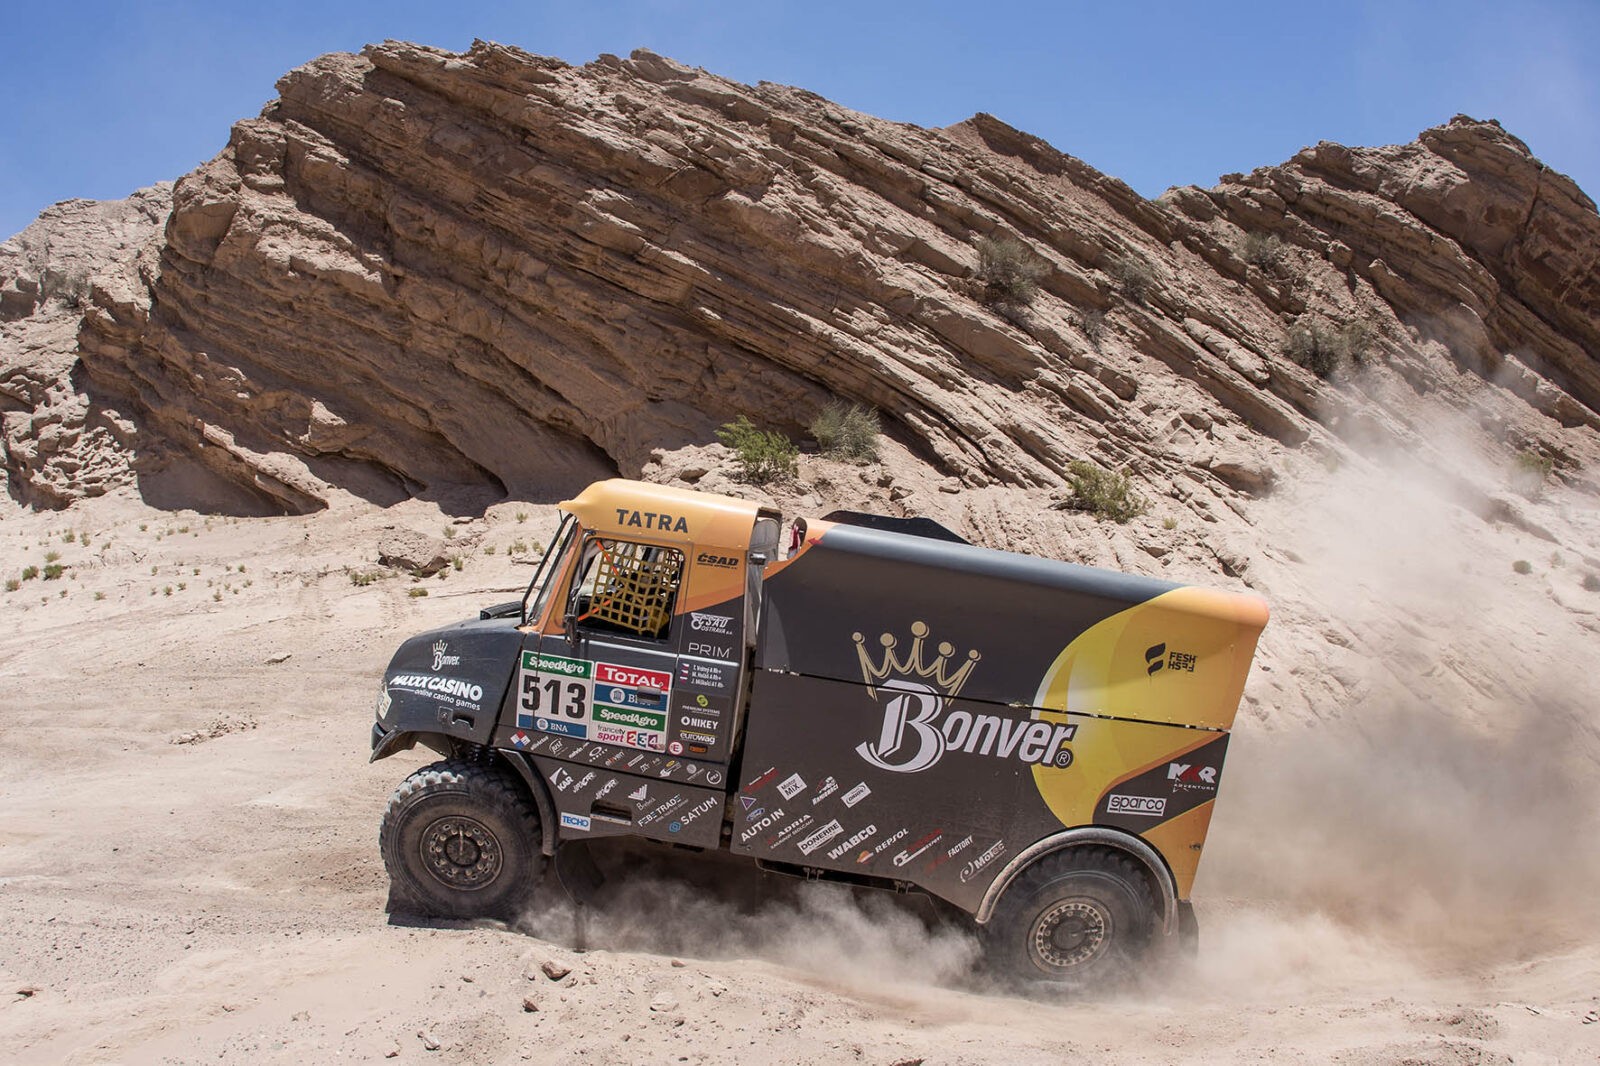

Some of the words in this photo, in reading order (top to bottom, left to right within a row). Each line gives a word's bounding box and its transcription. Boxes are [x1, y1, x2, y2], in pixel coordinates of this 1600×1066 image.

[616, 508, 688, 534] TATRA
[688, 642, 730, 659] PRIM
[1169, 651, 1197, 664] FESH
[529, 656, 585, 674] SpeedAgro
[427, 677, 483, 701] CASINO
[604, 667, 660, 688] TOTAL
[414, 688, 433, 698] online
[432, 692, 455, 704] casino
[455, 698, 481, 711] games
[522, 674, 587, 719] 513
[550, 722, 568, 733] BNA
[600, 708, 658, 727] SpeedAgro
[855, 677, 1076, 774] Bonver
[597, 732, 624, 743] sport
[556, 776, 574, 792] KAR
[680, 796, 718, 825] SATUM
[1110, 795, 1165, 812] sparco
[562, 815, 589, 828] TECHO
[741, 817, 772, 842] AUTO
[770, 808, 785, 822] IN
[777, 814, 812, 838] ADRIA
[800, 823, 840, 851] DONERRE
[827, 824, 877, 860] WABCO
[874, 828, 909, 854] REPSOL
[947, 835, 974, 858] FACTORY
